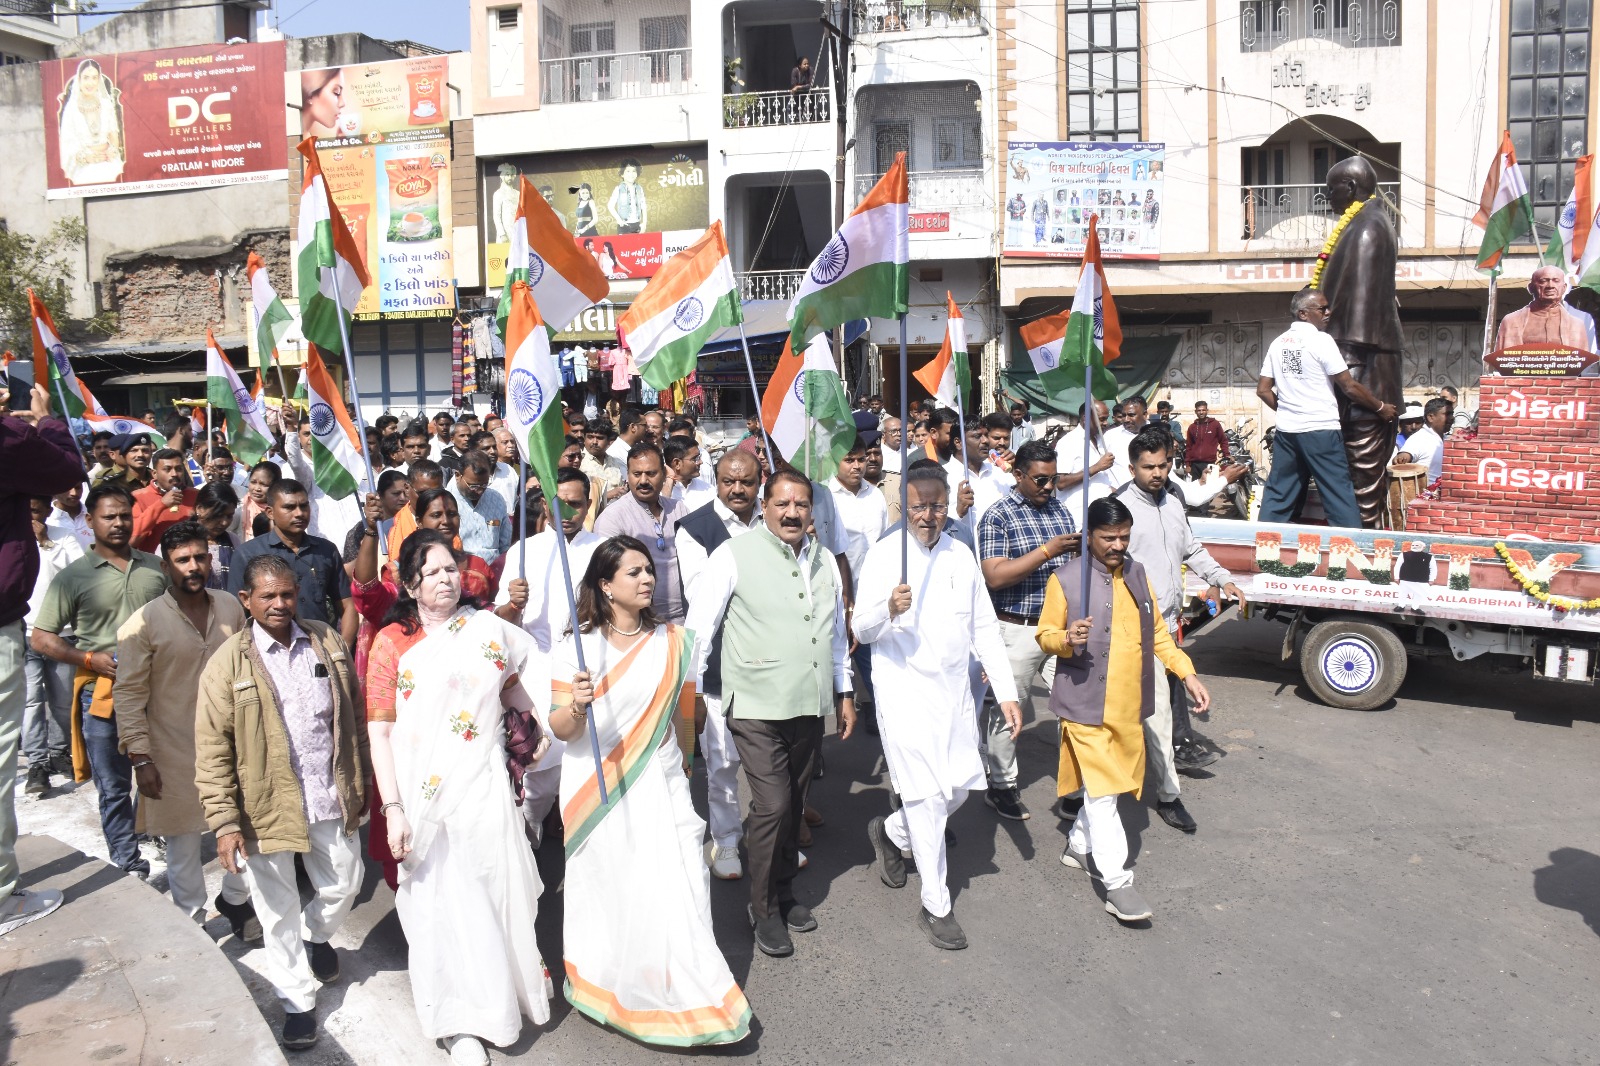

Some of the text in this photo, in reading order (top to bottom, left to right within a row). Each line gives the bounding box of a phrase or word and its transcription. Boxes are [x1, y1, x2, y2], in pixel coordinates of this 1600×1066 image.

[143, 73, 158, 82] 105
[181, 86, 217, 94] RATLAM'S
[167, 91, 232, 128] DC
[169, 123, 232, 136] JEWELLERS
[349, 137, 362, 145] Co.
[167, 157, 245, 172] RATLAM INDORE
[1049, 161, 1130, 175] વિશ્વ આદિવાસી દિવસ
[658, 168, 704, 188] રંગોલી
[398, 181, 428, 193] ROYAL
[926, 213, 948, 229] દર્શન
[389, 252, 408, 263] કિલો
[411, 254, 421, 262] ચા
[424, 250, 450, 262] ખરીદો
[631, 247, 645, 257] નથી
[648, 255, 663, 264] નથી
[407, 265, 424, 274] અને
[395, 277, 420, 291] કિલો
[424, 276, 449, 288] ખાંડ
[384, 293, 450, 308] મફત મેળવો.
[359, 312, 380, 321] SILIGURI
[405, 309, 436, 319] DARJEELING
[1494, 389, 1586, 420] એકતા
[1477, 457, 1585, 491] નિડરતા
[1255, 531, 1582, 591] UNTY
[1264, 581, 1288, 590] 150
[1293, 583, 1336, 594] YEARS
[1341, 587, 1360, 596] OF
[1427, 594, 1522, 609] ALLABHBHAI
